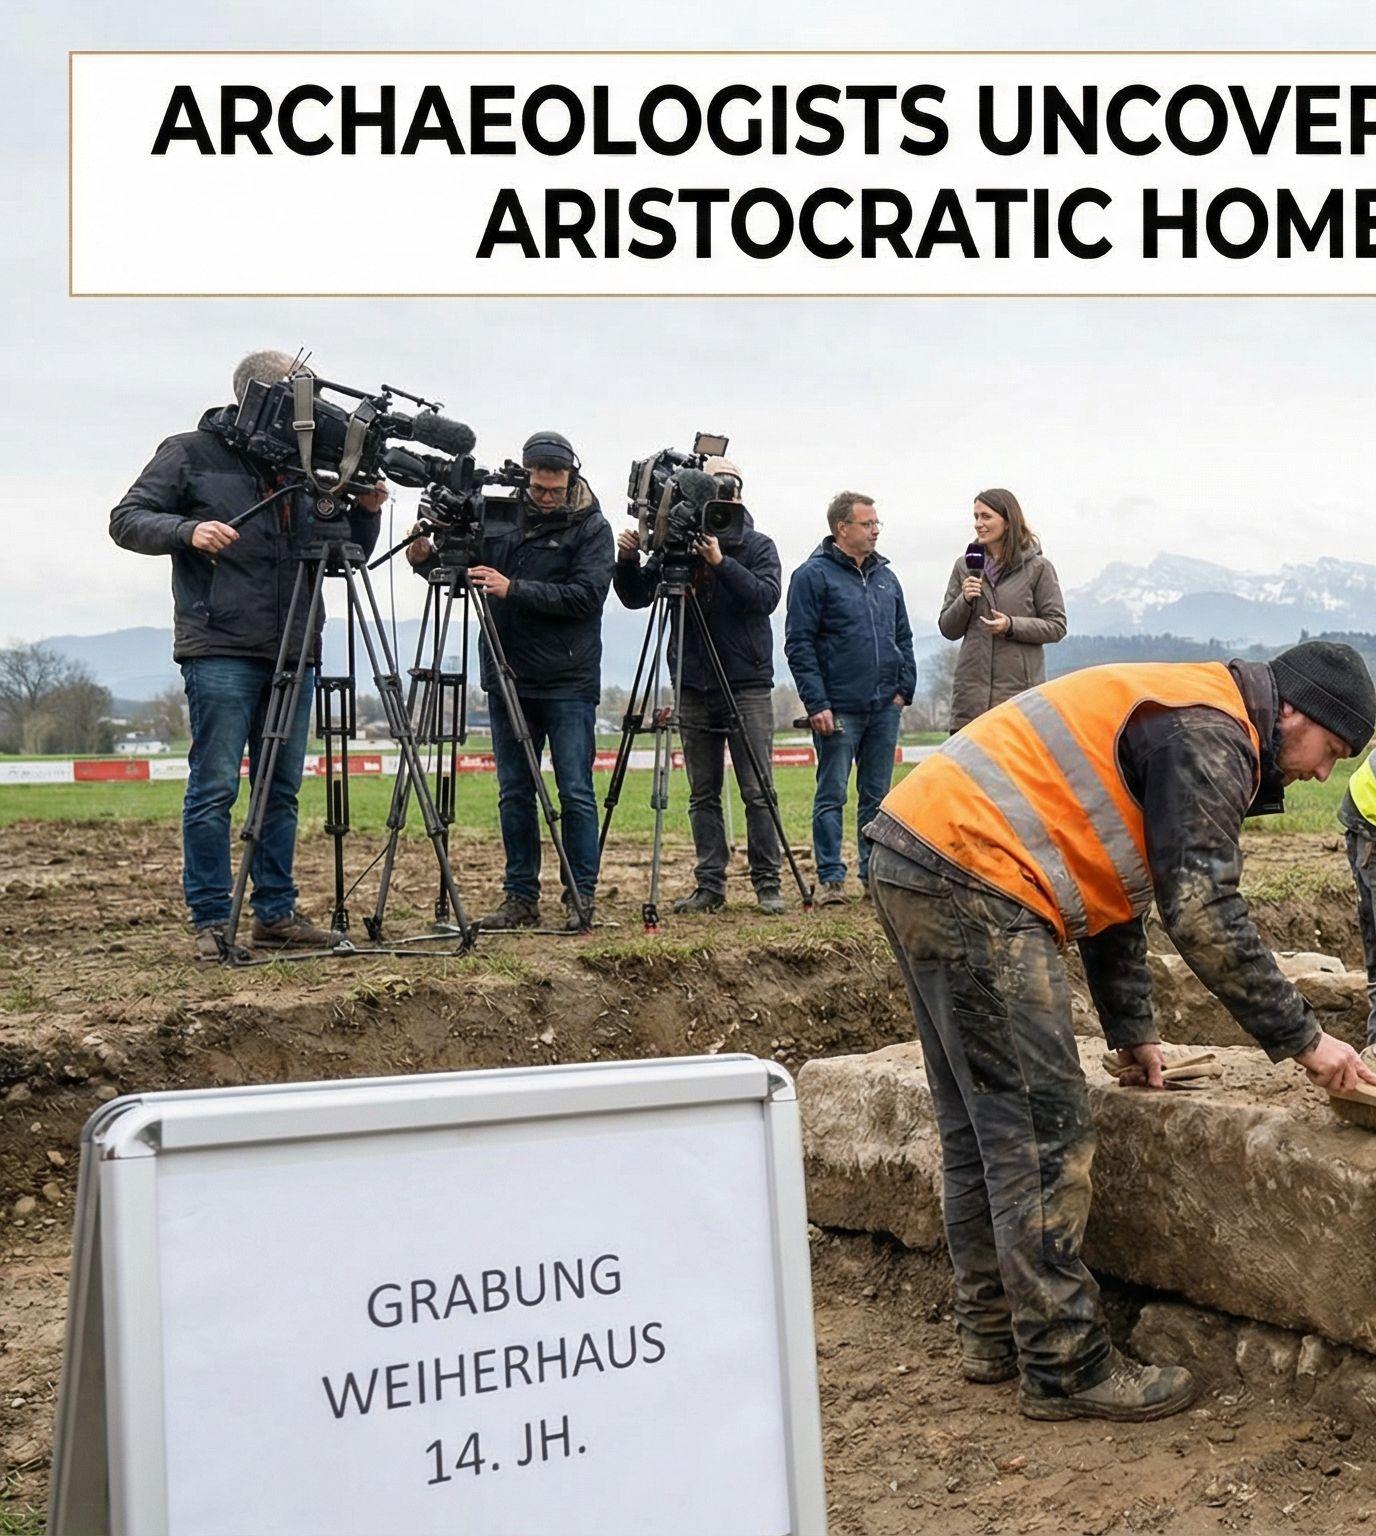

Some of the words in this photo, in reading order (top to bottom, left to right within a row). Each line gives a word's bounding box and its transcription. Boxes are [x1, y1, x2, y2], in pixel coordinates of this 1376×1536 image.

[367, 1253, 622, 1328] GRABUNG
[321, 1321, 666, 1420] WEIHERHAUS
[425, 1431, 500, 1486] 14.
[516, 1414, 587, 1468] JH.
